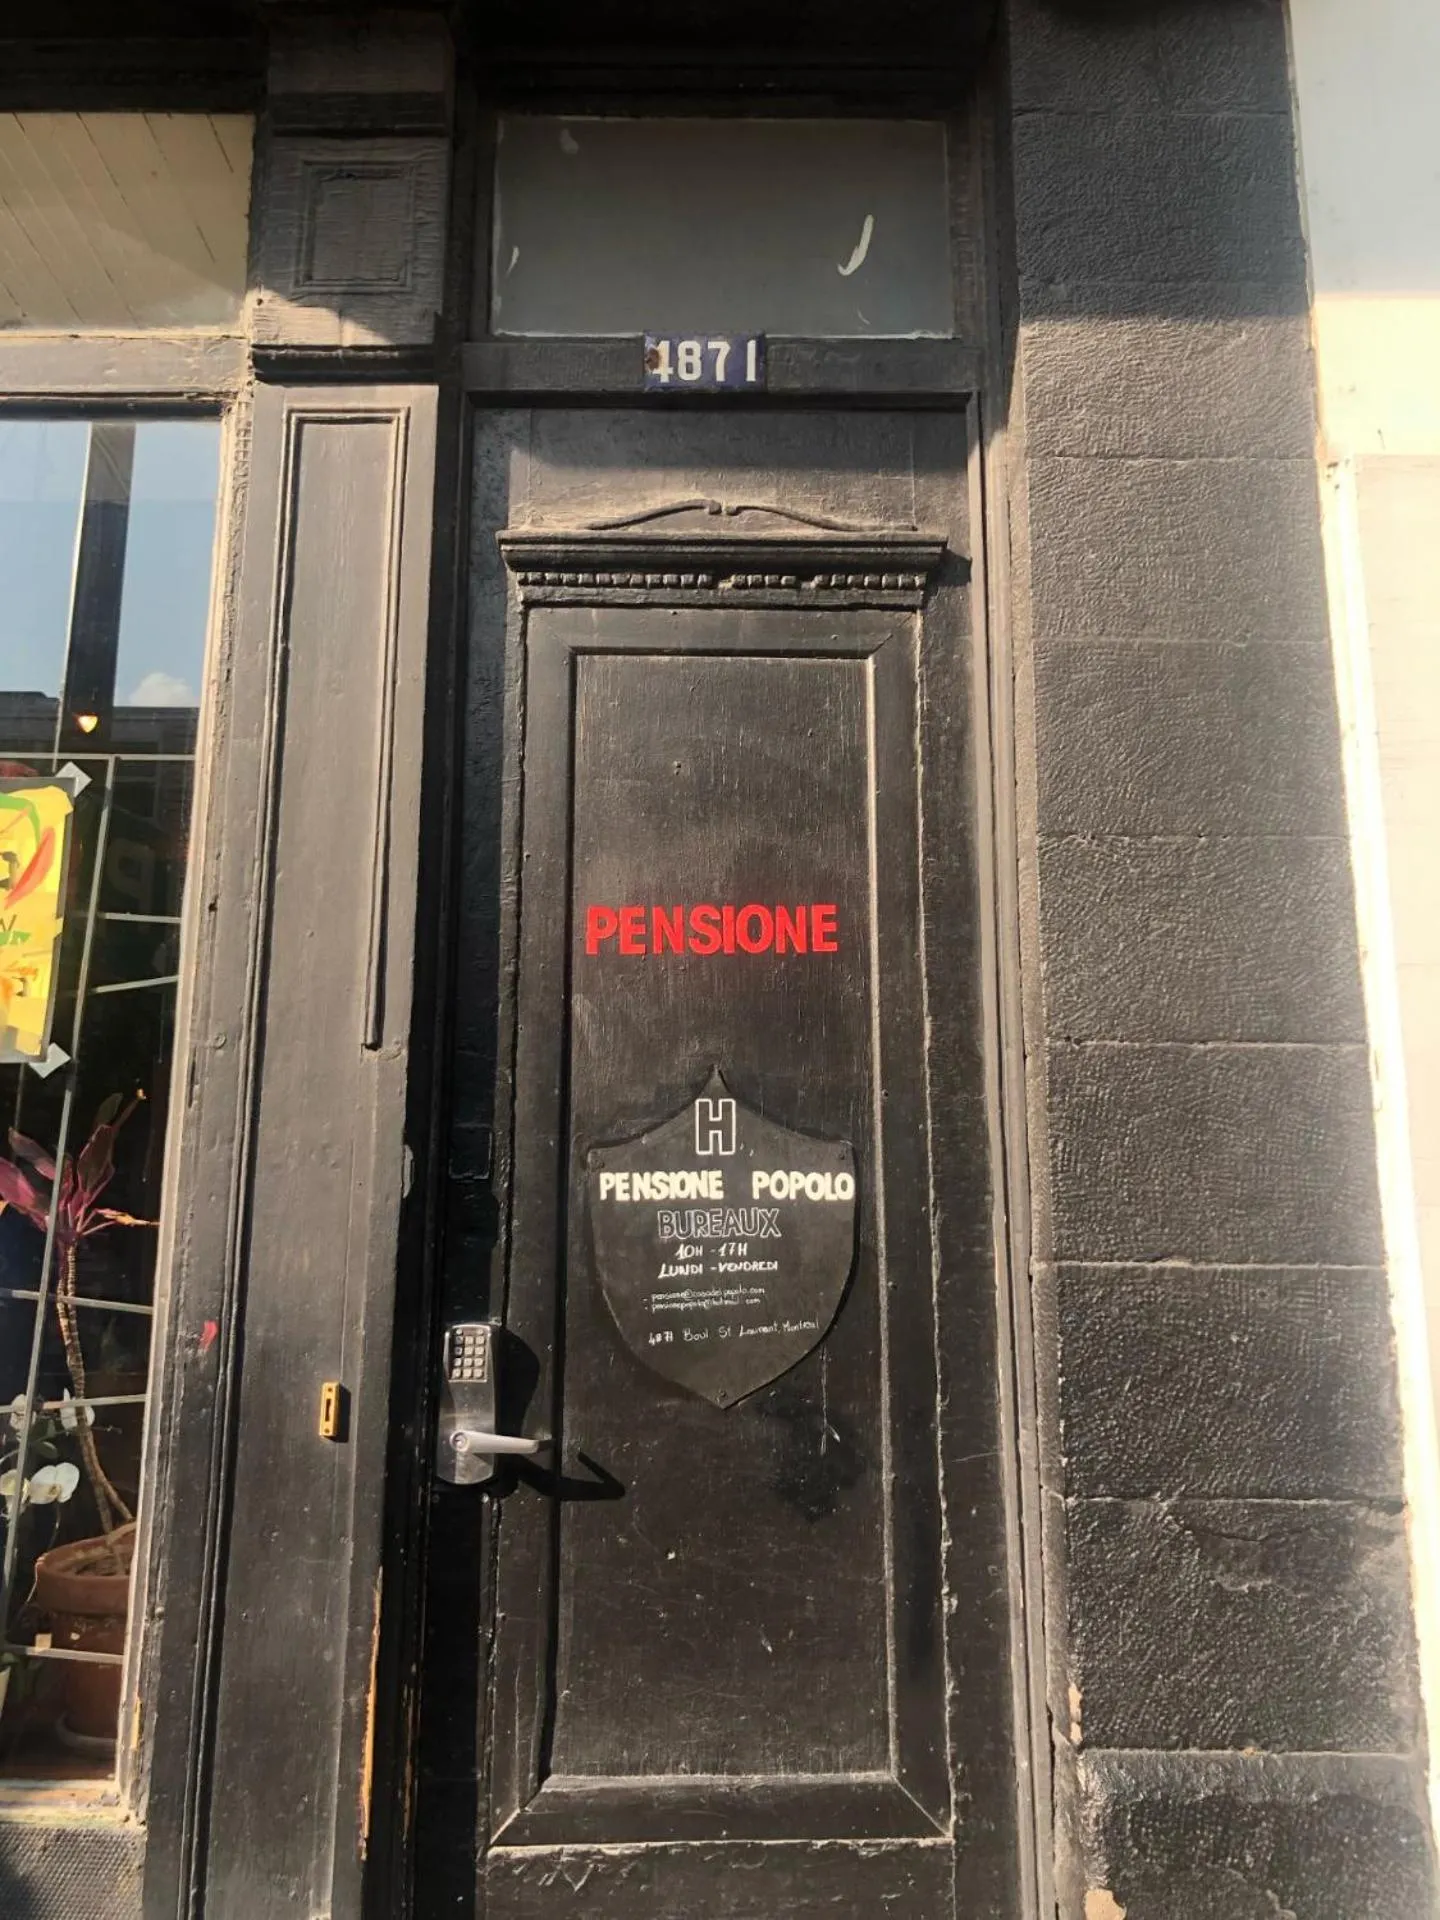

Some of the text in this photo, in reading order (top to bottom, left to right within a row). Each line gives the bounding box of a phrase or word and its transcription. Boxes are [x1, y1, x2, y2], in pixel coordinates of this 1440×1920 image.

[651, 339, 757, 384] 4871
[585, 903, 839, 956] PENSIONE
[695, 1099, 737, 1156] H
[599, 1170, 856, 1202] PENSIONE POPOLO
[657, 1207, 782, 1239] BUREAUX
[658, 1263, 703, 1279] LUNDI
